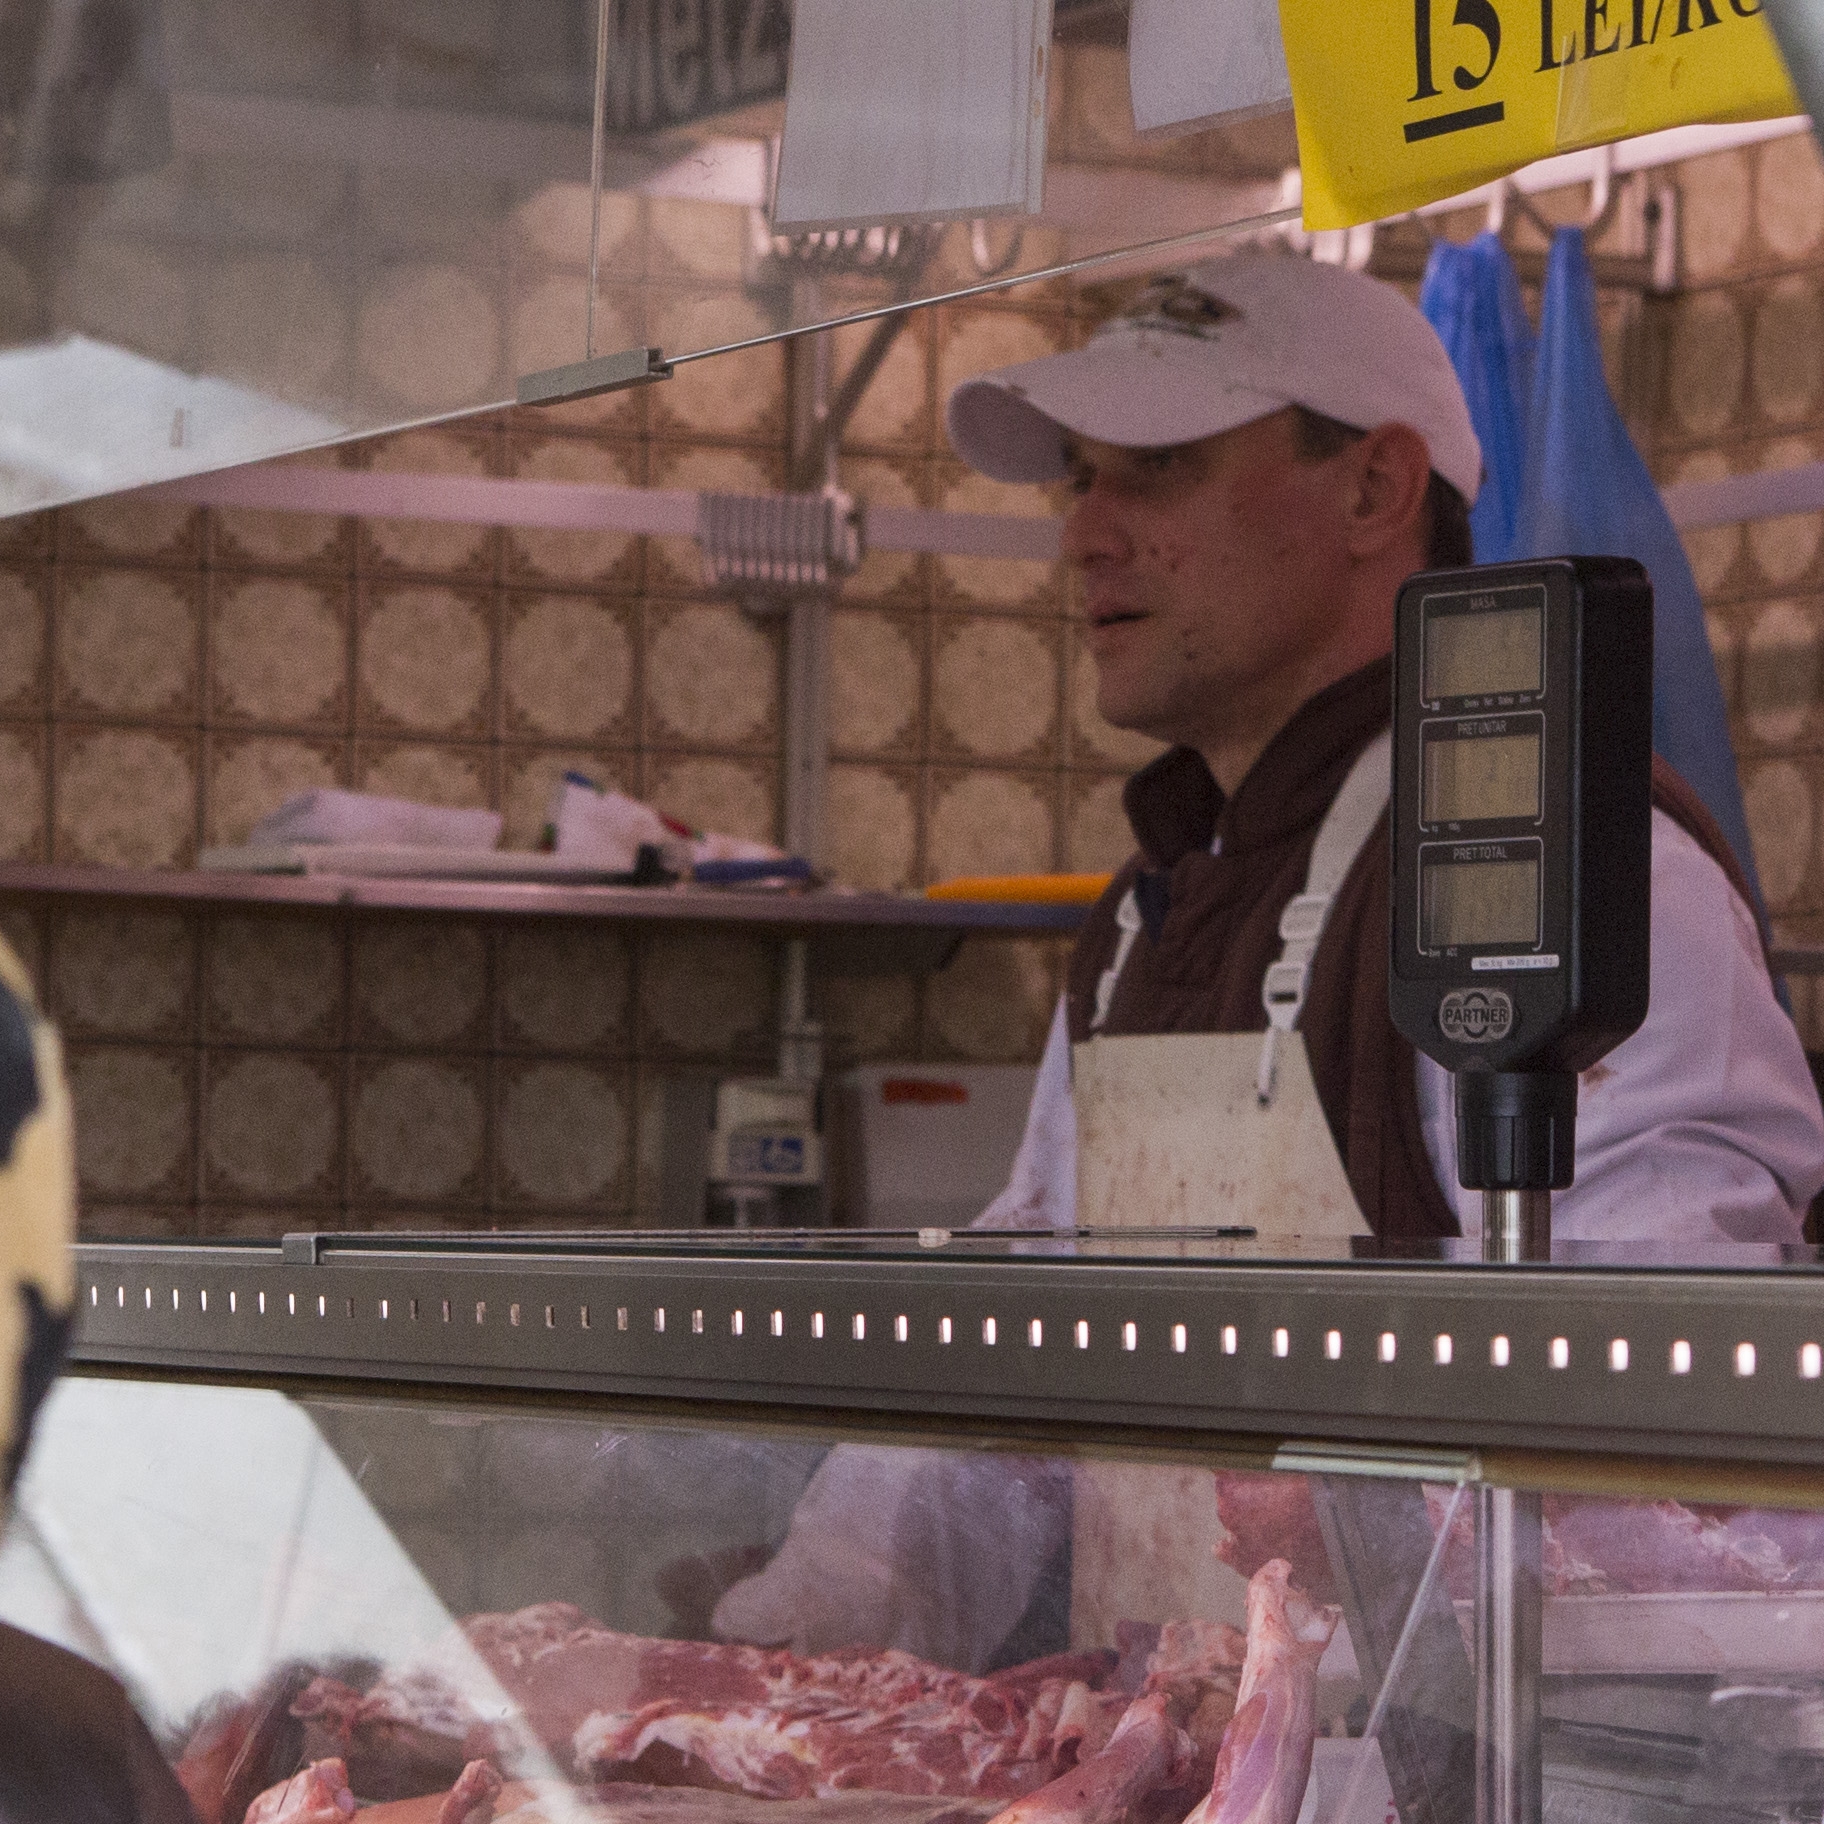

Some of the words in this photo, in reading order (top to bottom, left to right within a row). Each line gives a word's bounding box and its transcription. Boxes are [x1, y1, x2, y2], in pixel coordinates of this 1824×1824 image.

[1406, 0, 1502, 103] 15
[1533, 0, 1765, 76] LEI/
[1478, 719, 1507, 734] UNITAR
[1453, 848, 1476, 860] PRET
[1479, 846, 1508, 860] TOTAL
[1444, 1007, 1509, 1023] PARTNER
